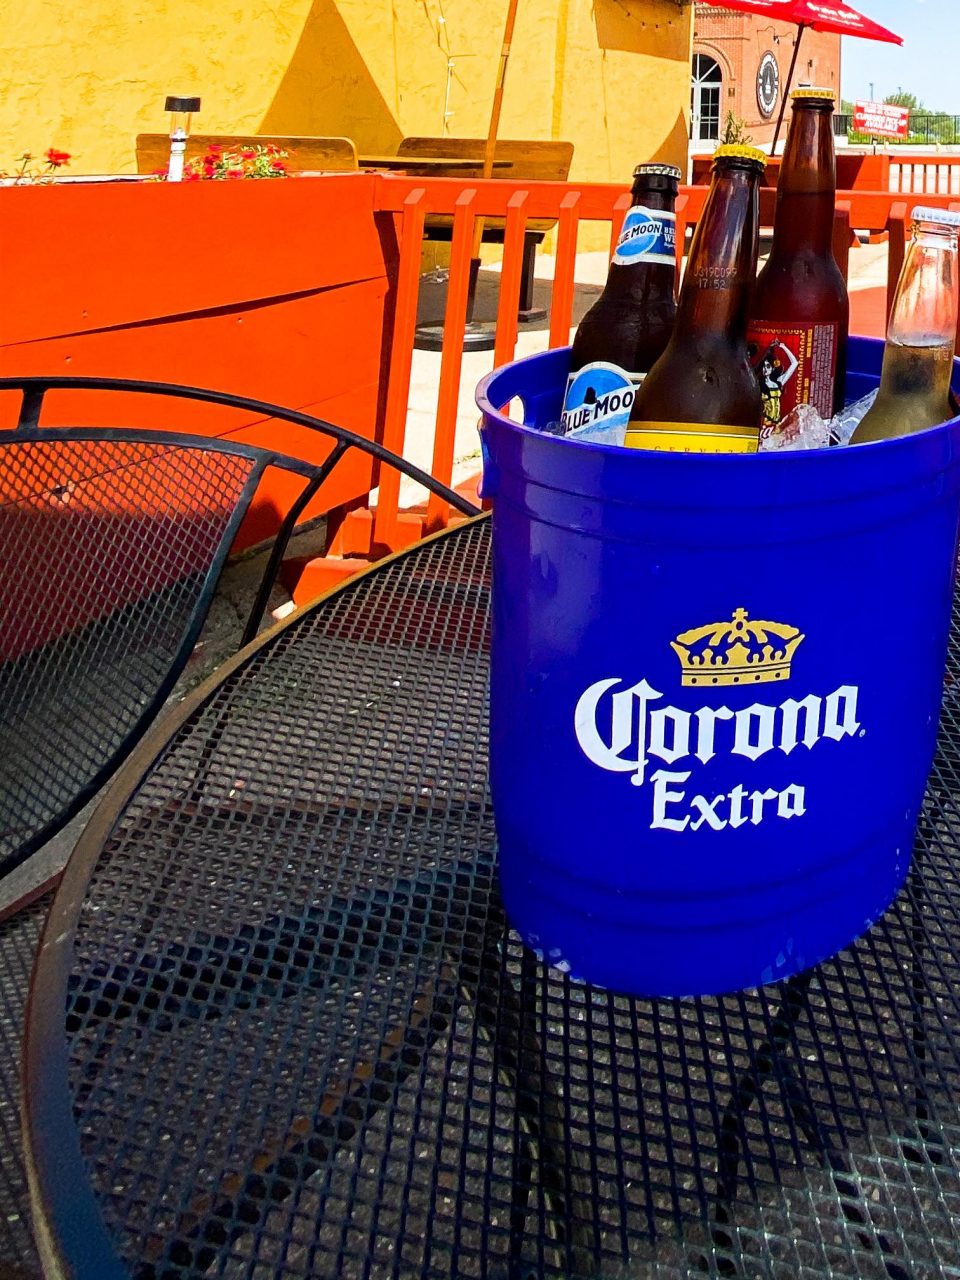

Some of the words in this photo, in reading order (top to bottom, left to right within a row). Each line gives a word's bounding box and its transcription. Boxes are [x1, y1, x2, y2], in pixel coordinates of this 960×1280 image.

[631, 223, 661, 239] MOON
[561, 407, 591, 434] BLUE
[574, 677, 861, 787] Corona
[650, 769, 807, 832] Extra
